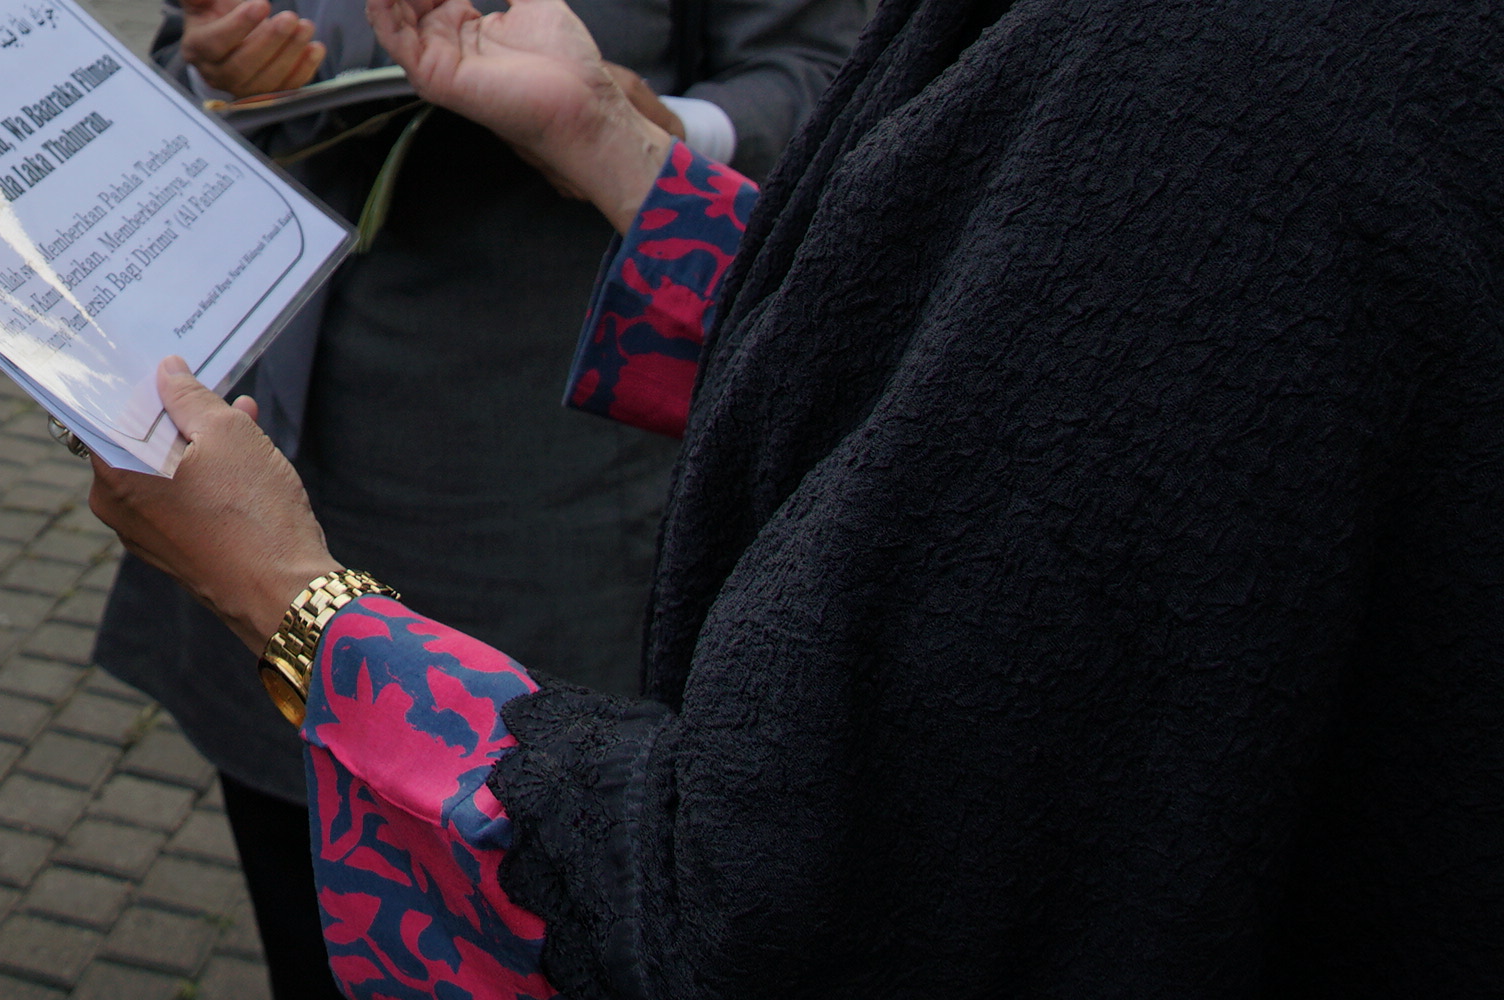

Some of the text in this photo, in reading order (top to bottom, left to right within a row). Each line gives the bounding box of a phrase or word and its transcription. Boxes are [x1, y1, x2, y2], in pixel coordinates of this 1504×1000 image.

[0, 115, 34, 141] Wa
[21, 81, 83, 128] Baaraka
[70, 54, 120, 93] Fiimaa
[10, 153, 54, 187] Laka
[41, 112, 113, 164] Thahuran.
[96, 172, 143, 209] Pahala
[133, 135, 190, 177] Terhadap
[180, 157, 209, 177] dan
[104, 257, 142, 291] Bagi
